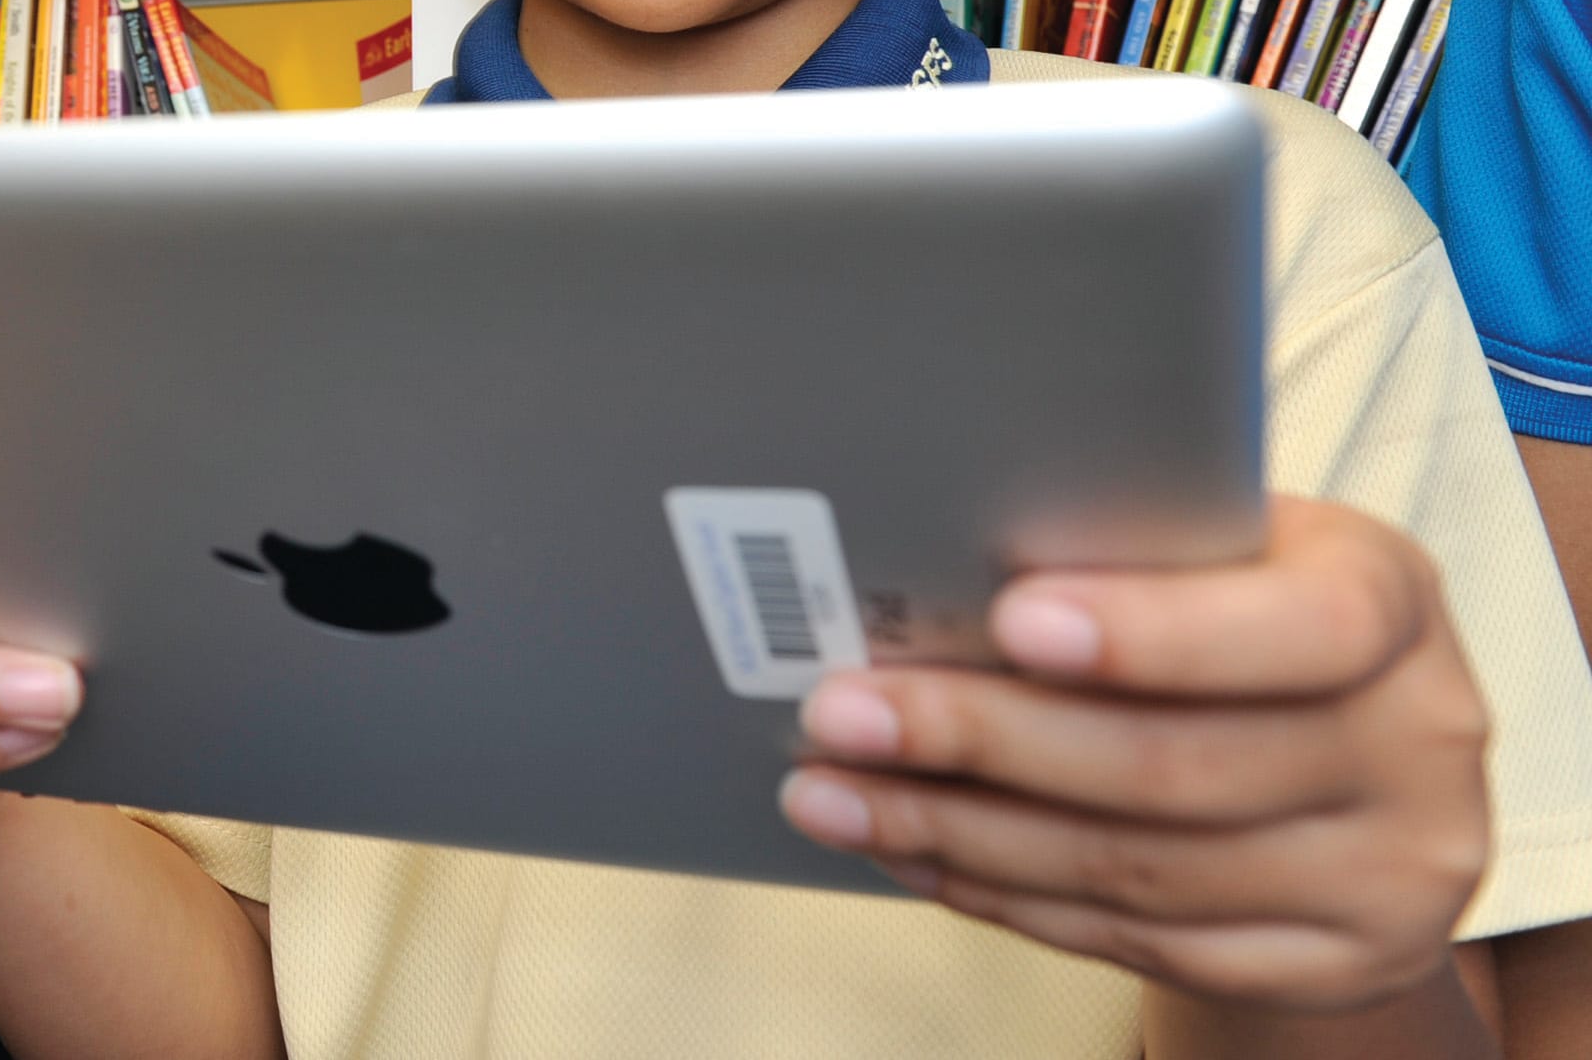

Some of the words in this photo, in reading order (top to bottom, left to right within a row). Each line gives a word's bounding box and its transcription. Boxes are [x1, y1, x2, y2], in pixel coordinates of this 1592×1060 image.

[10, 9, 22, 37] Smith
[1133, 11, 1147, 33] AND
[1126, 36, 1139, 56] THE
